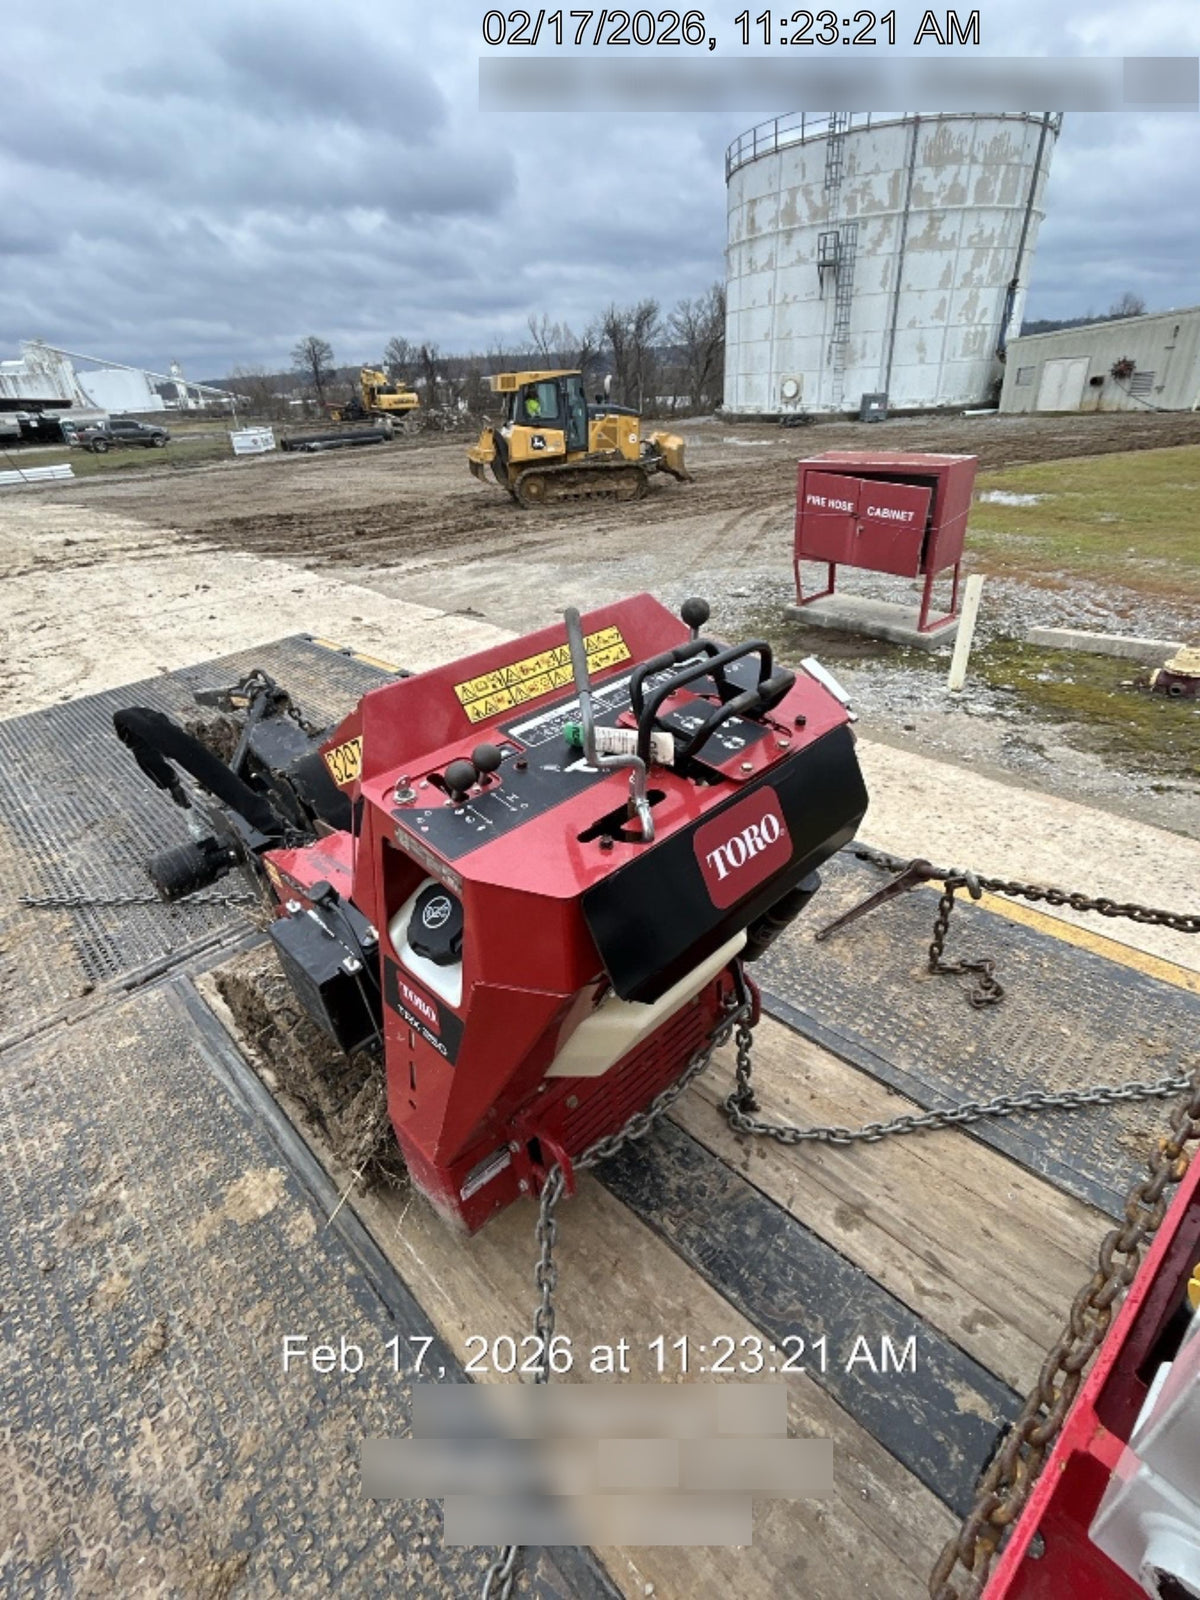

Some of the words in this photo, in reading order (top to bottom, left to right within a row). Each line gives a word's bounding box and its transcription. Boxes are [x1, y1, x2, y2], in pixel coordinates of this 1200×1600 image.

[806, 494, 826, 508] FIRE
[828, 498, 854, 513] HOSE
[867, 506, 915, 522] CABINET
[705, 813, 780, 881] TORO
[400, 980, 438, 1025] TORO
